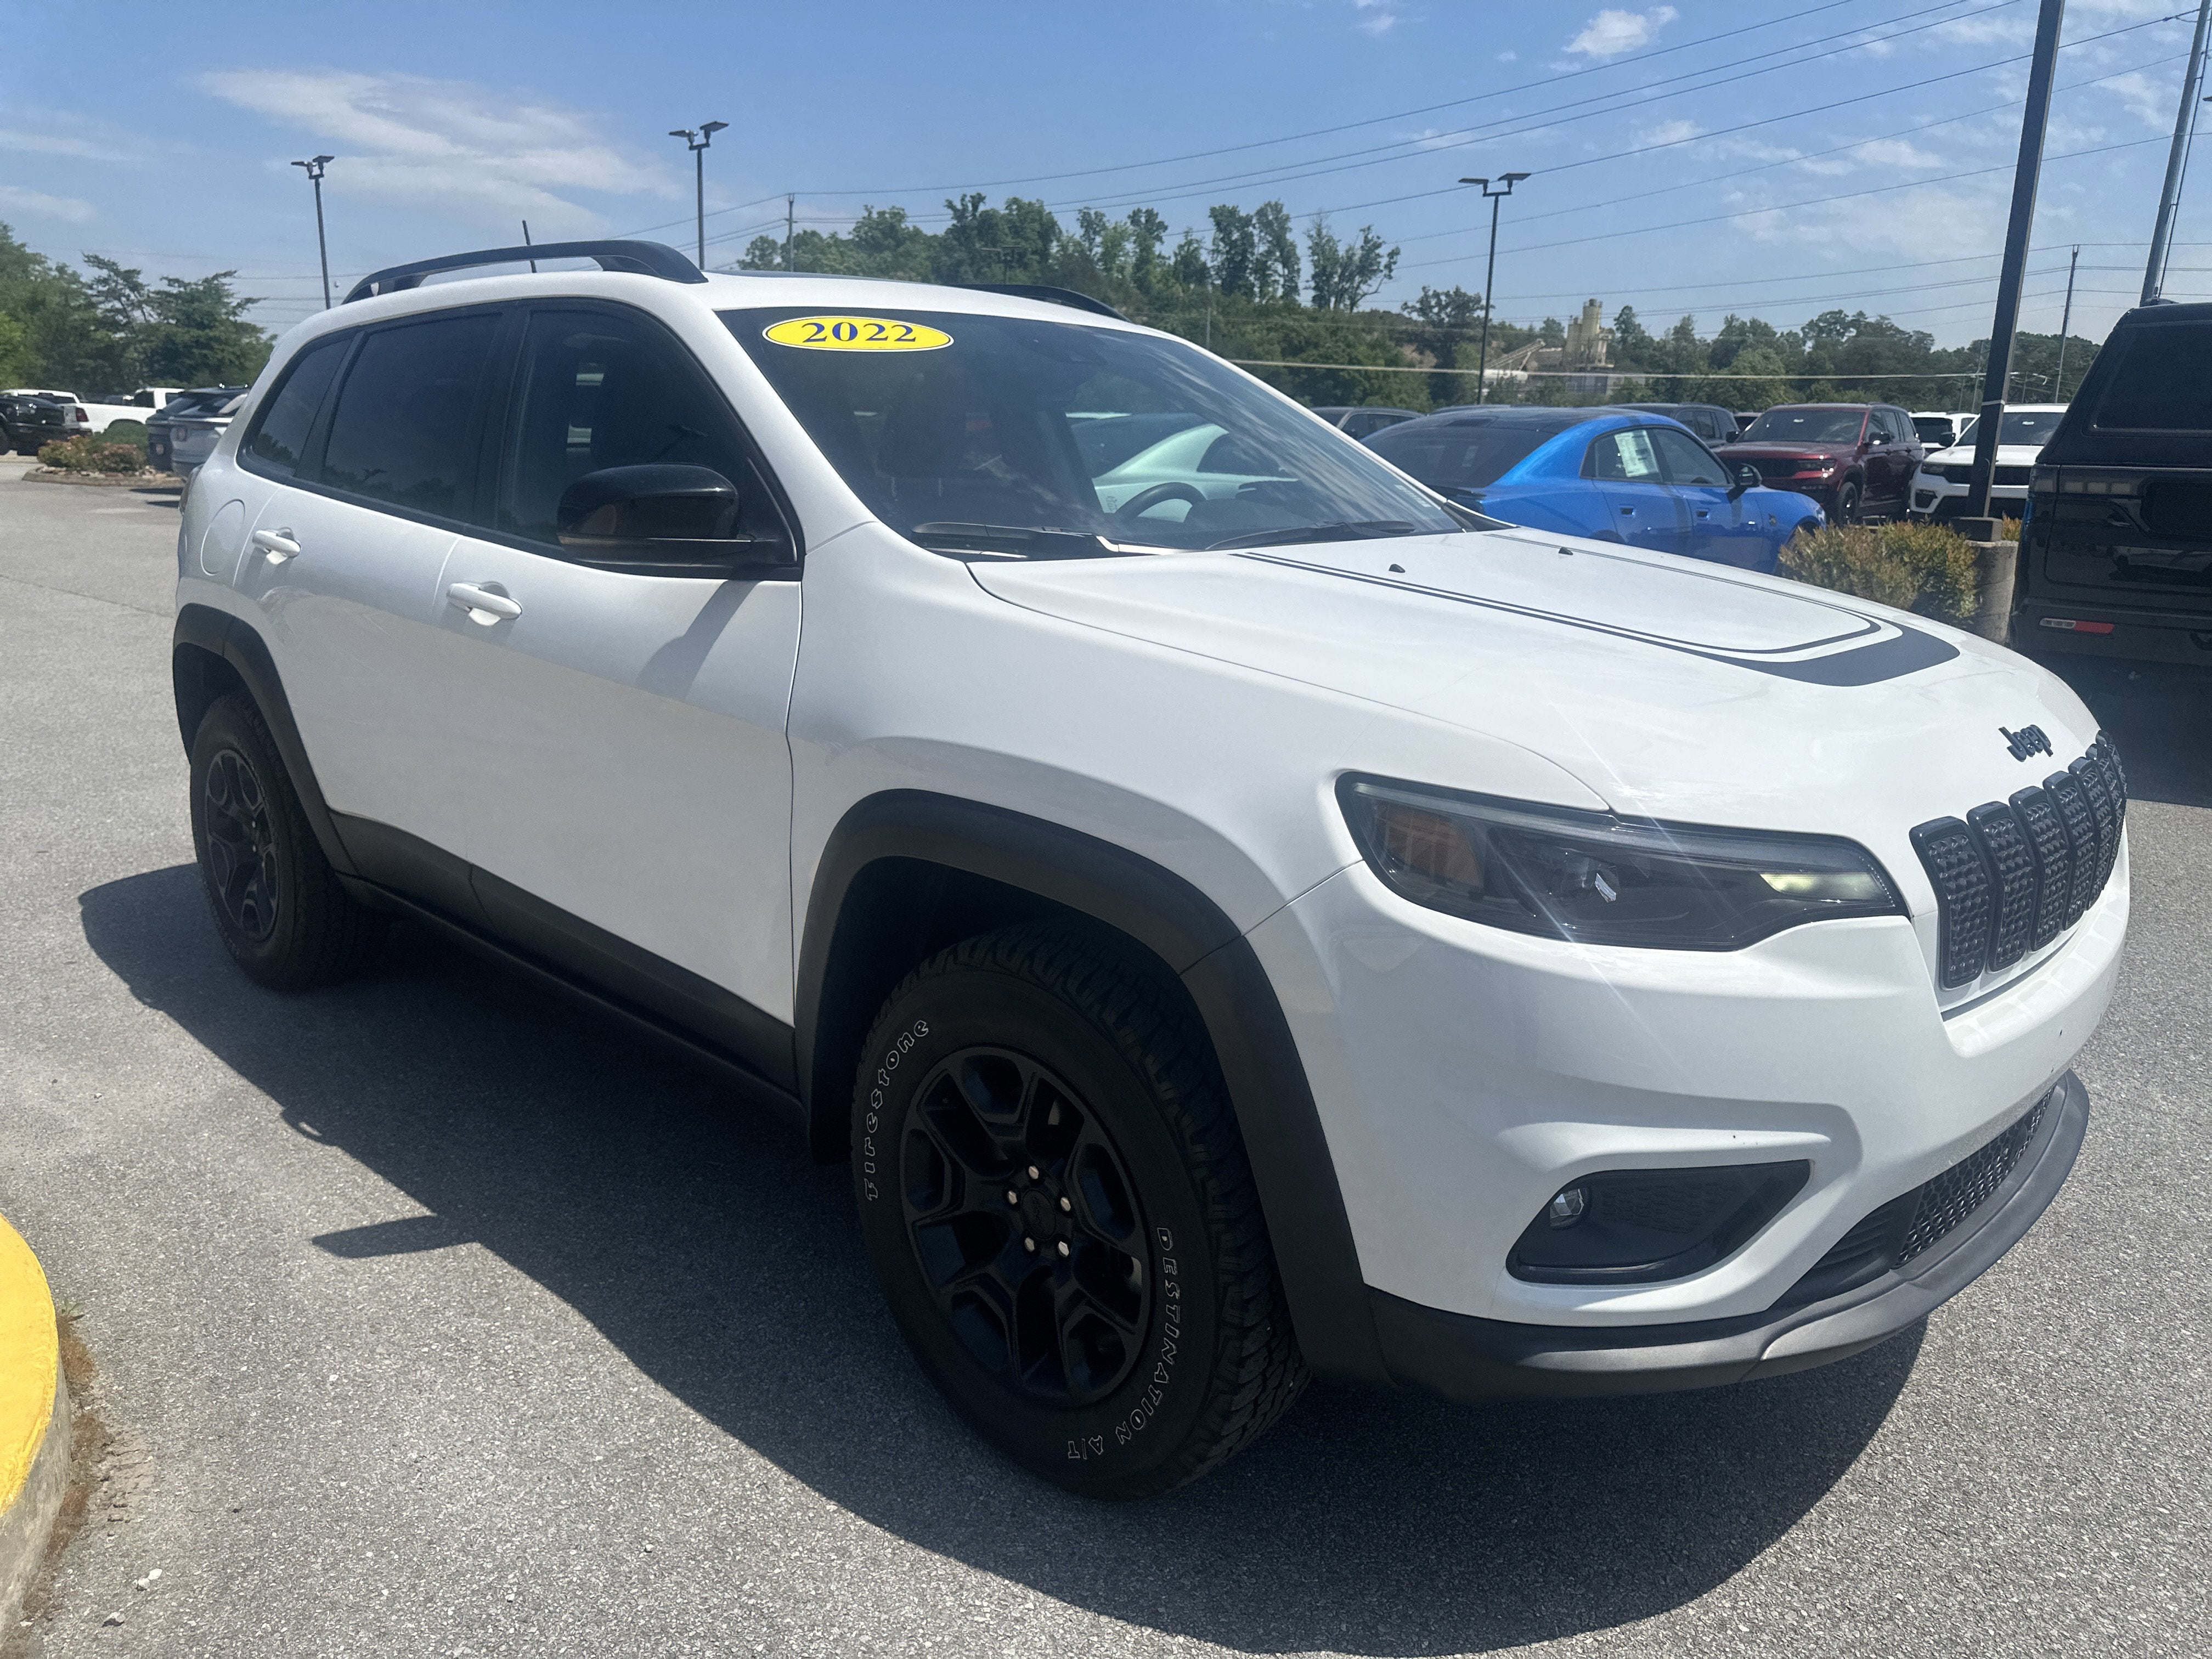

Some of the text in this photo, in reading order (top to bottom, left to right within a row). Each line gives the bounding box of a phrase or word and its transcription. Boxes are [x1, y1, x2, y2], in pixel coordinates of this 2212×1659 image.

[801, 321, 917, 343] 2022
[1998, 724, 2053, 763] Jeep
[1068, 1227, 1181, 1460] DESTINATION A/T
